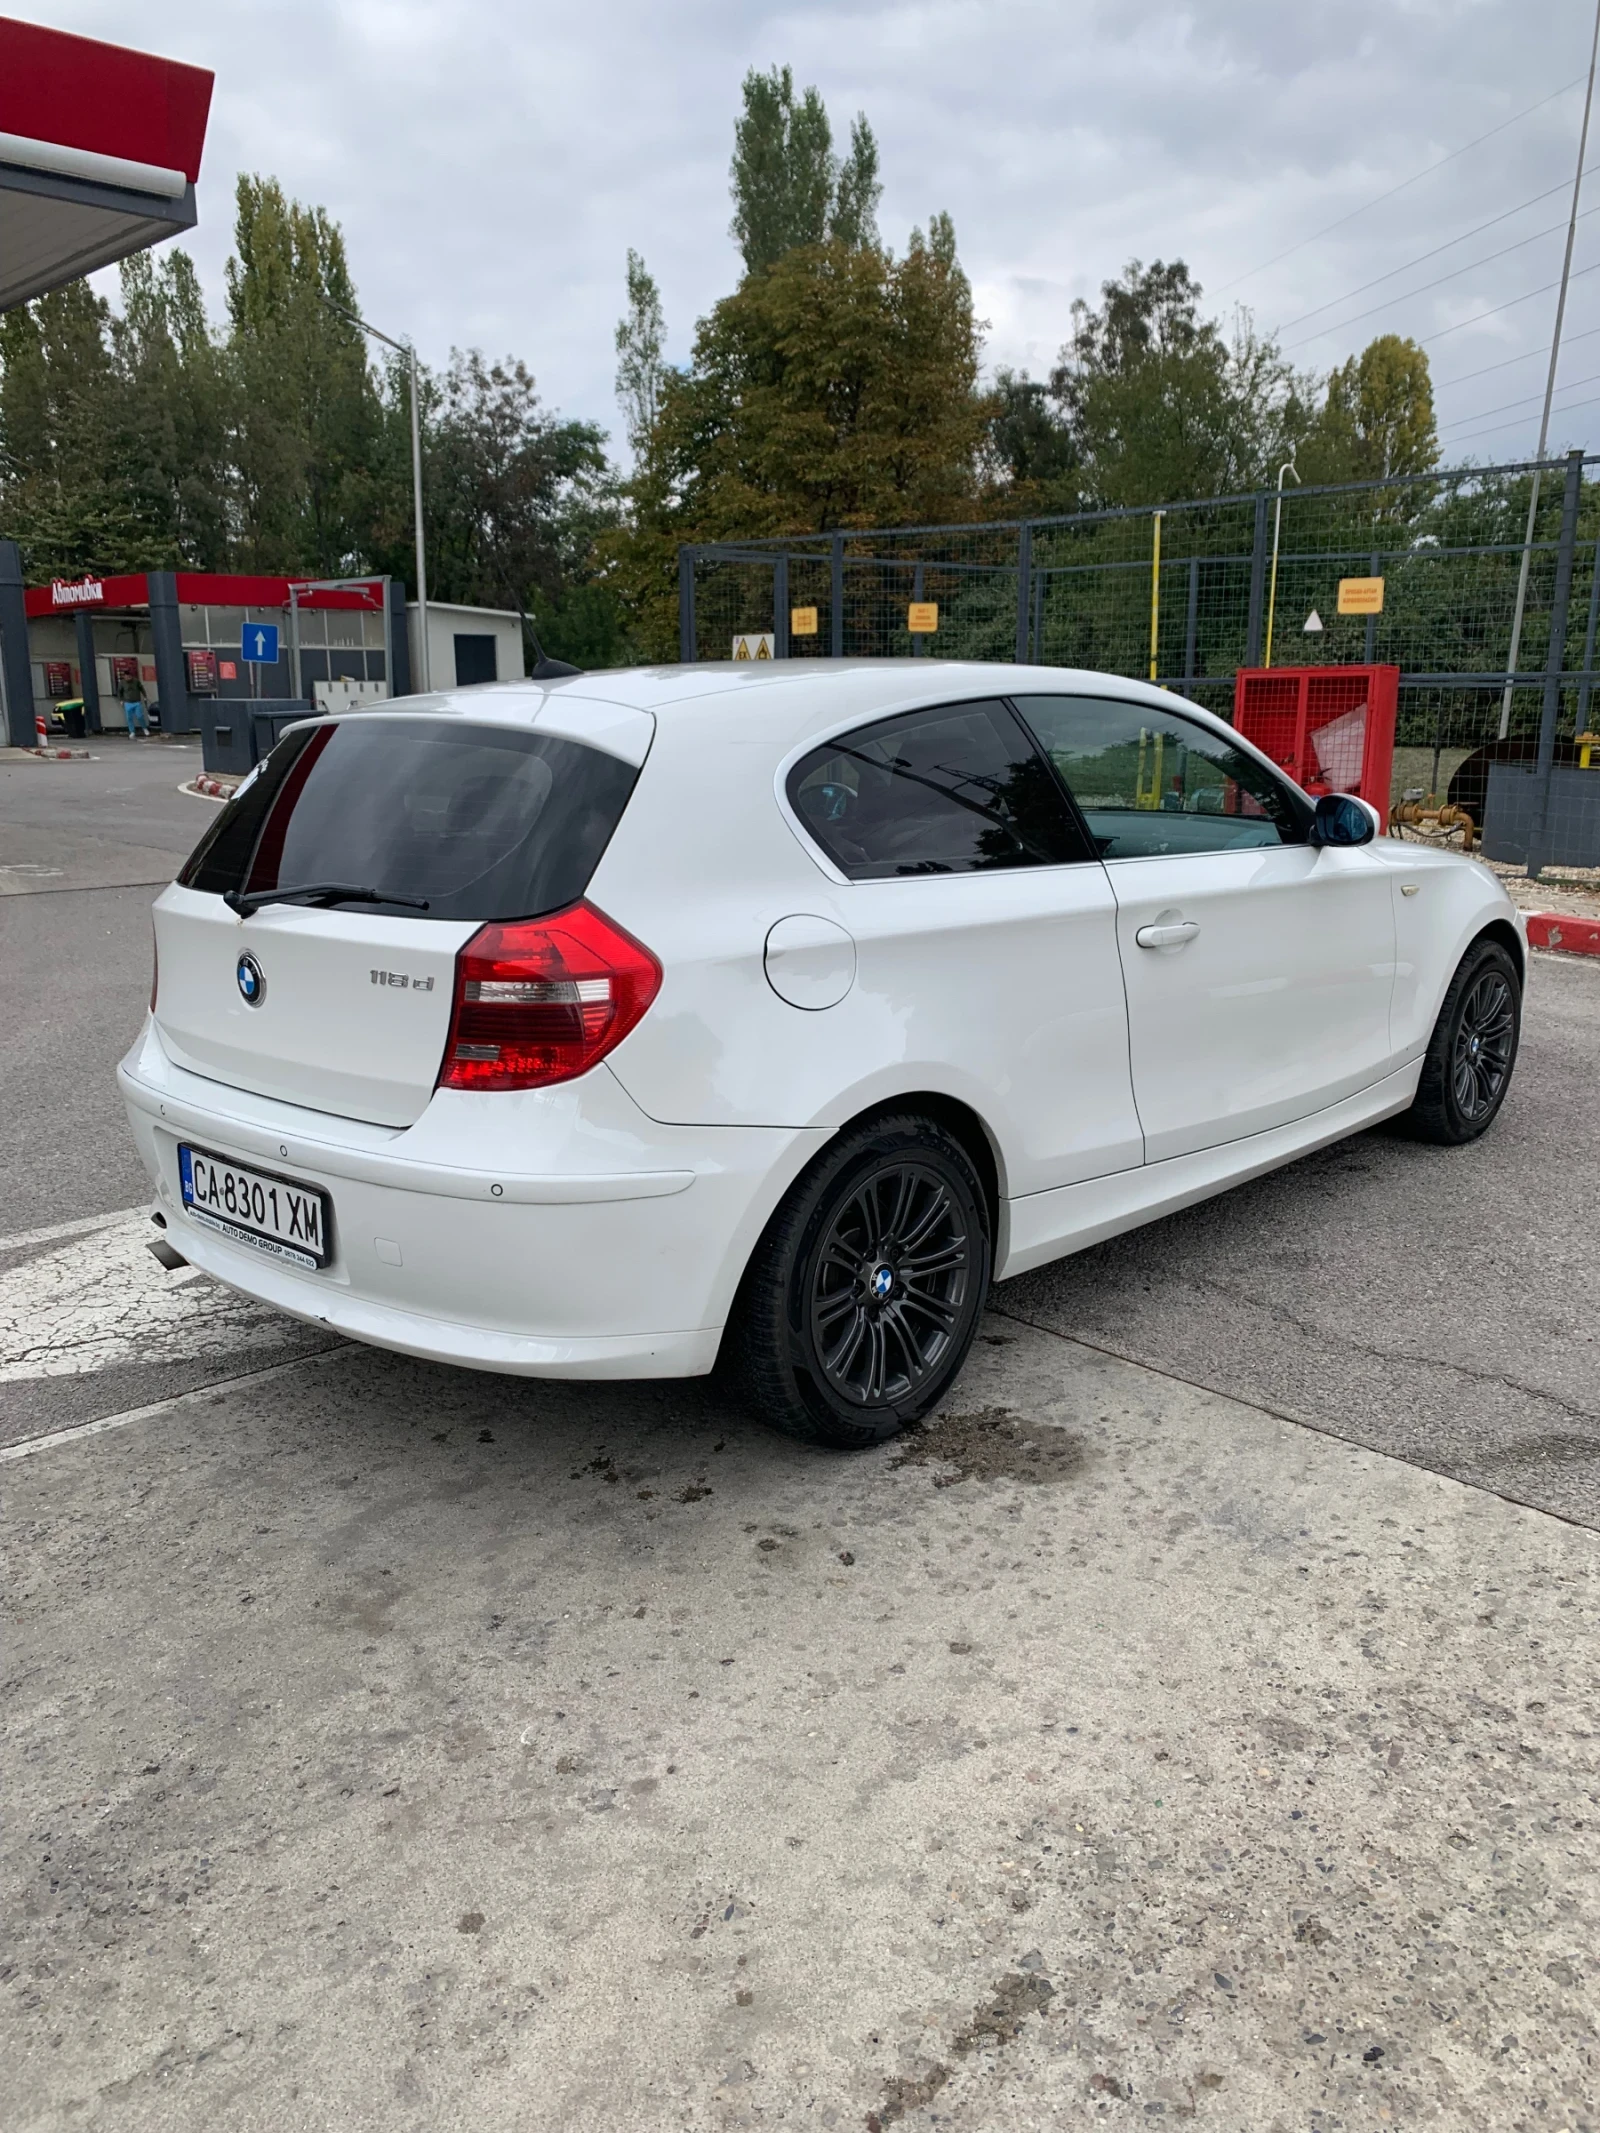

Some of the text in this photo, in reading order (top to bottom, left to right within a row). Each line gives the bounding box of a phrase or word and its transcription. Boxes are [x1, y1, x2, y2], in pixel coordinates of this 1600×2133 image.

[370, 969, 435, 992] 118d
[184, 1180, 193, 1195] BG
[222, 1224, 238, 1237] AUTO
[239, 1230, 257, 1245] DEMO
[258, 1239, 282, 1254] GROUP
